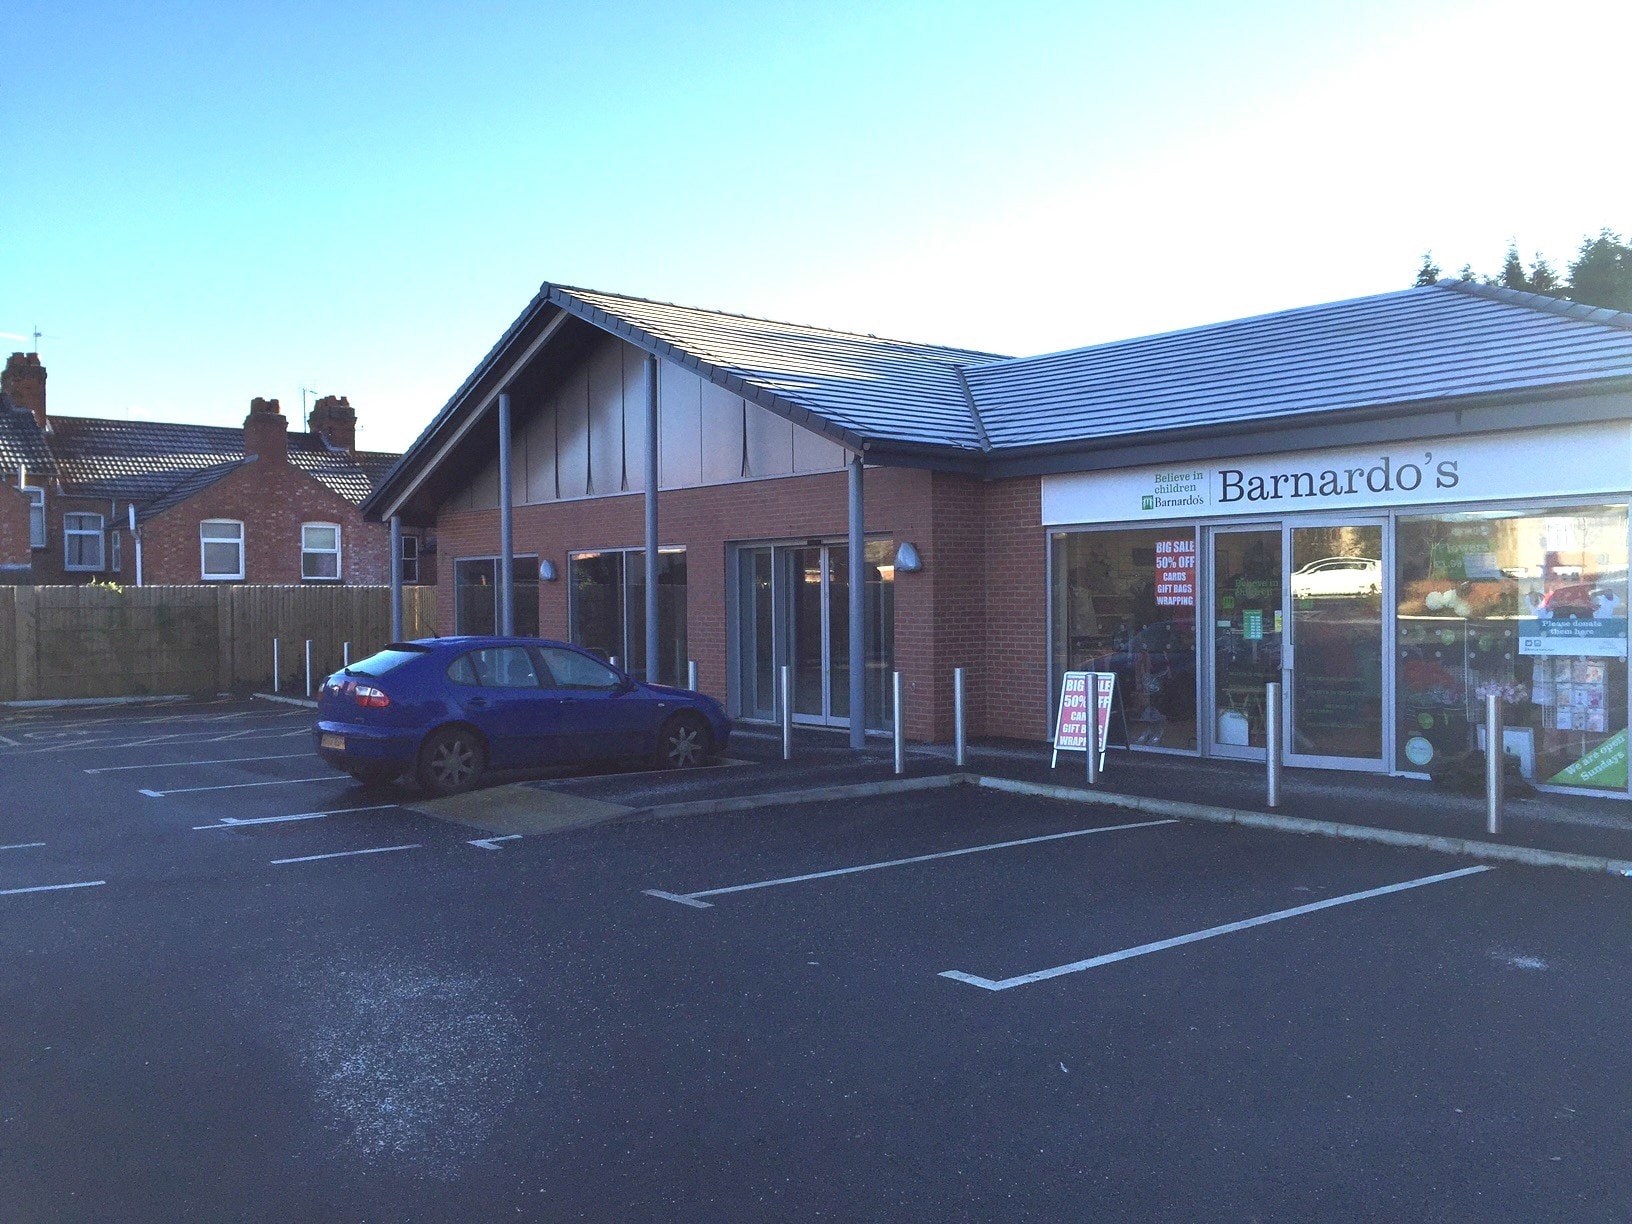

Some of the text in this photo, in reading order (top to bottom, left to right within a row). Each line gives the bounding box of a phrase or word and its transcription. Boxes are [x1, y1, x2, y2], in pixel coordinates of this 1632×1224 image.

[1154, 471, 1203, 483] Believe in
[1218, 452, 1459, 503] Barnardo's
[1154, 484, 1196, 494] children
[1155, 495, 1204, 507] Barnardo's
[1156, 541, 1195, 553] BIG SALE
[1156, 556, 1195, 568] 50% OFF
[1163, 572, 1186, 582] CARDS
[1157, 584, 1193, 593] GIFT BAGS
[1156, 596, 1194, 606] WRAPPING
[1066, 679, 1084, 692] BIG
[1064, 694, 1087, 708] 50%
[1062, 723, 1103, 735] GIFT BS
[1565, 736, 1625, 775] We are open
[1581, 751, 1625, 781] Sundays
